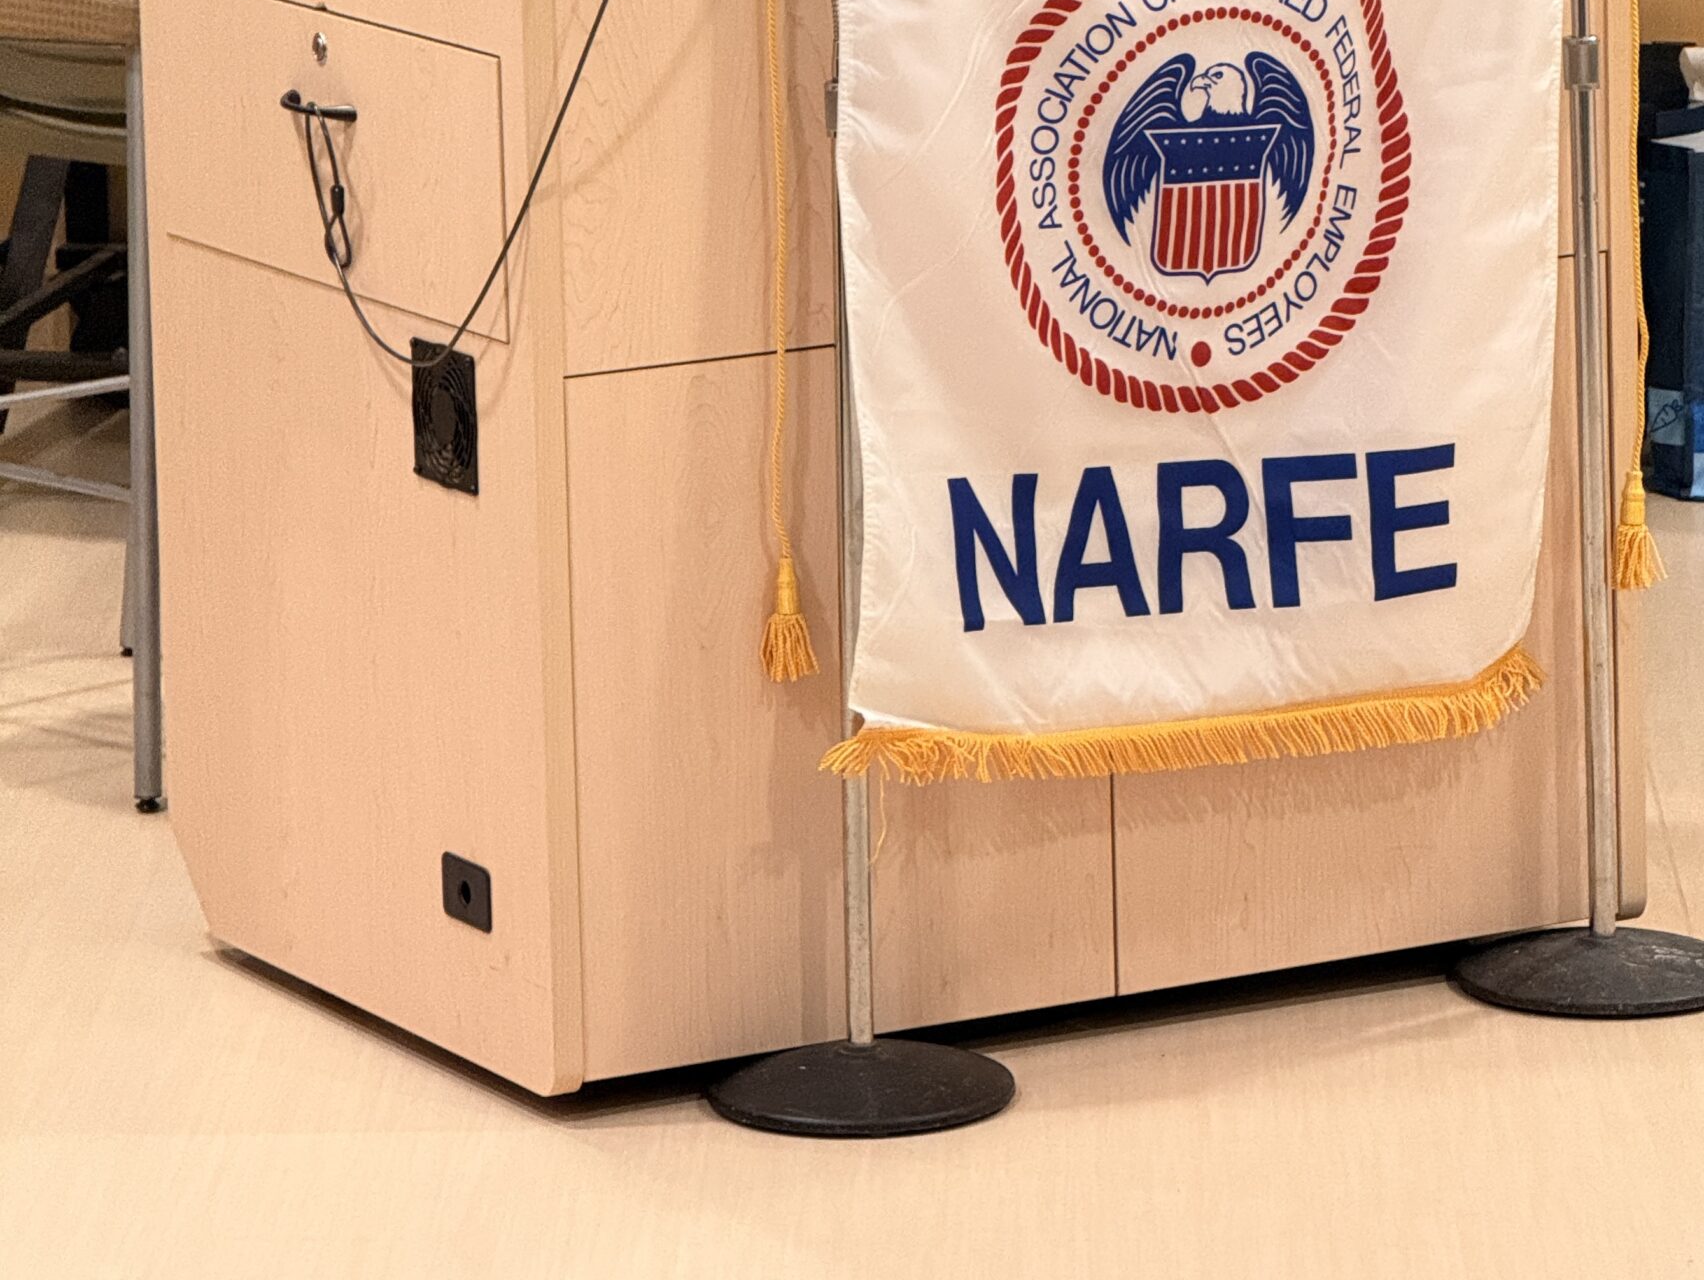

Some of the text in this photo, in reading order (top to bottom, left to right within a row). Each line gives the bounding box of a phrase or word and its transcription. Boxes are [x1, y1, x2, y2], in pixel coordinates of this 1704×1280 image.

[1030, 1, 1137, 229] ASSOCIATION
[1326, 15, 1362, 169] FEDERAL
[1052, 240, 1178, 360] NATIONAL
[1224, 184, 1358, 356] EMPLOYEES
[947, 443, 1458, 633] NARFE
